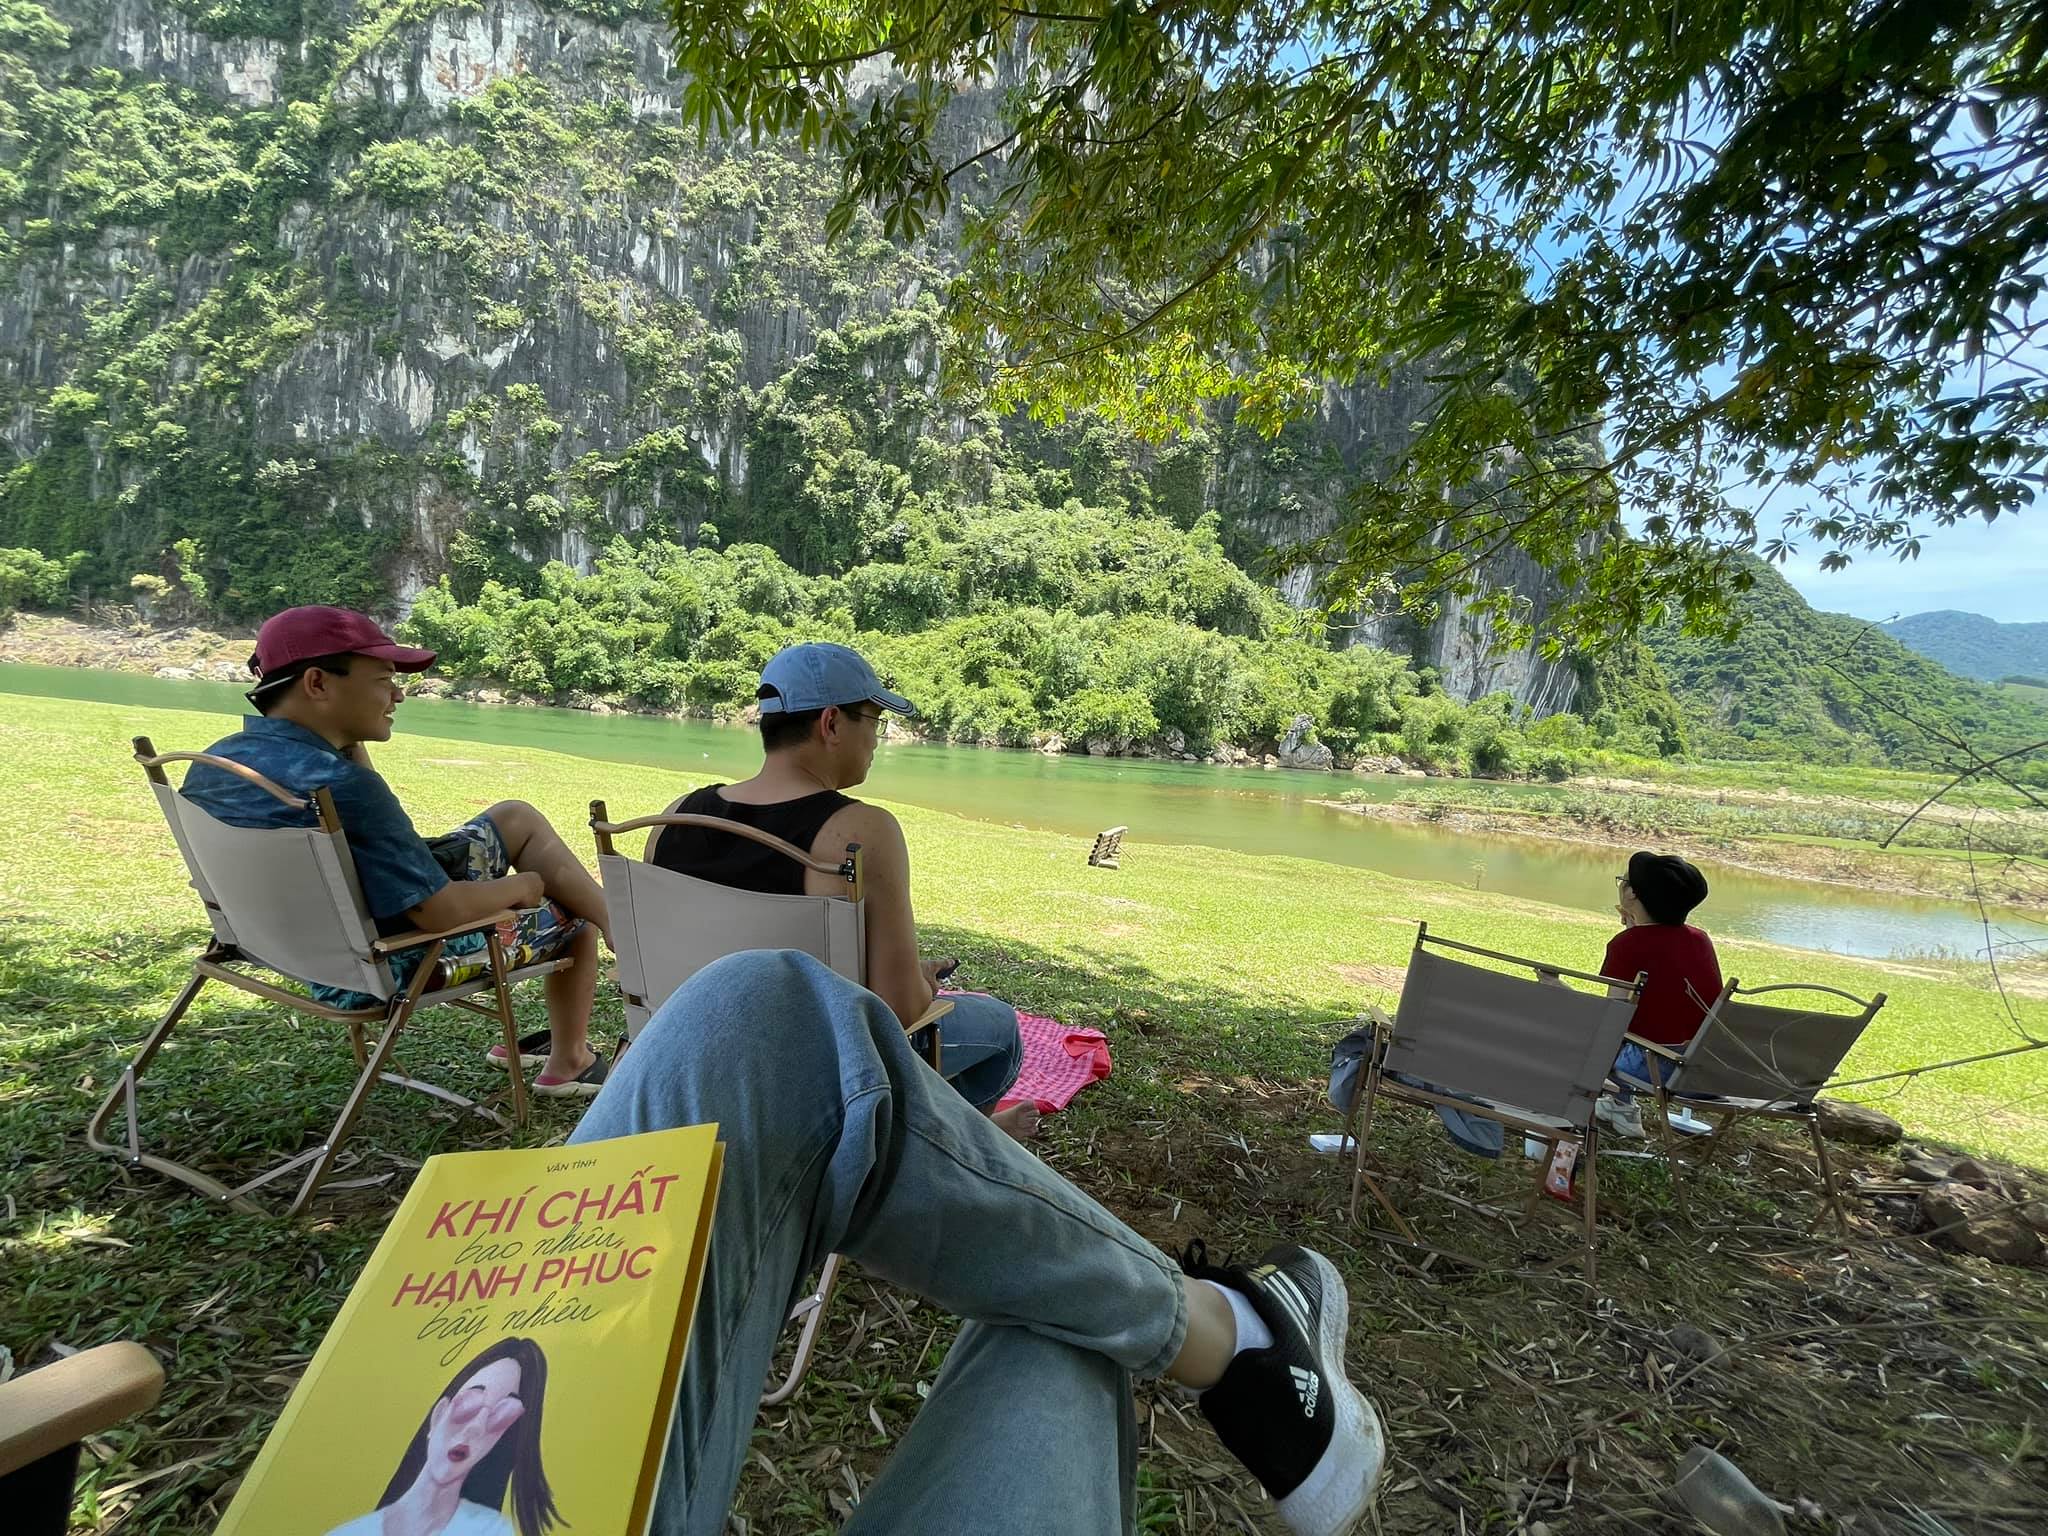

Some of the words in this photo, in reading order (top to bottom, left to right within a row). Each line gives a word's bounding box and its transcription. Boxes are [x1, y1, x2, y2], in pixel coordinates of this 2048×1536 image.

[427, 1185, 538, 1239] KHÍ
[538, 1165, 680, 1229] CHẤT
[454, 1231, 523, 1265] bao
[392, 1264, 526, 1308] HẠNH
[501, 1290, 601, 1331] nhiêu
[1304, 1370, 1319, 1418] adidas
